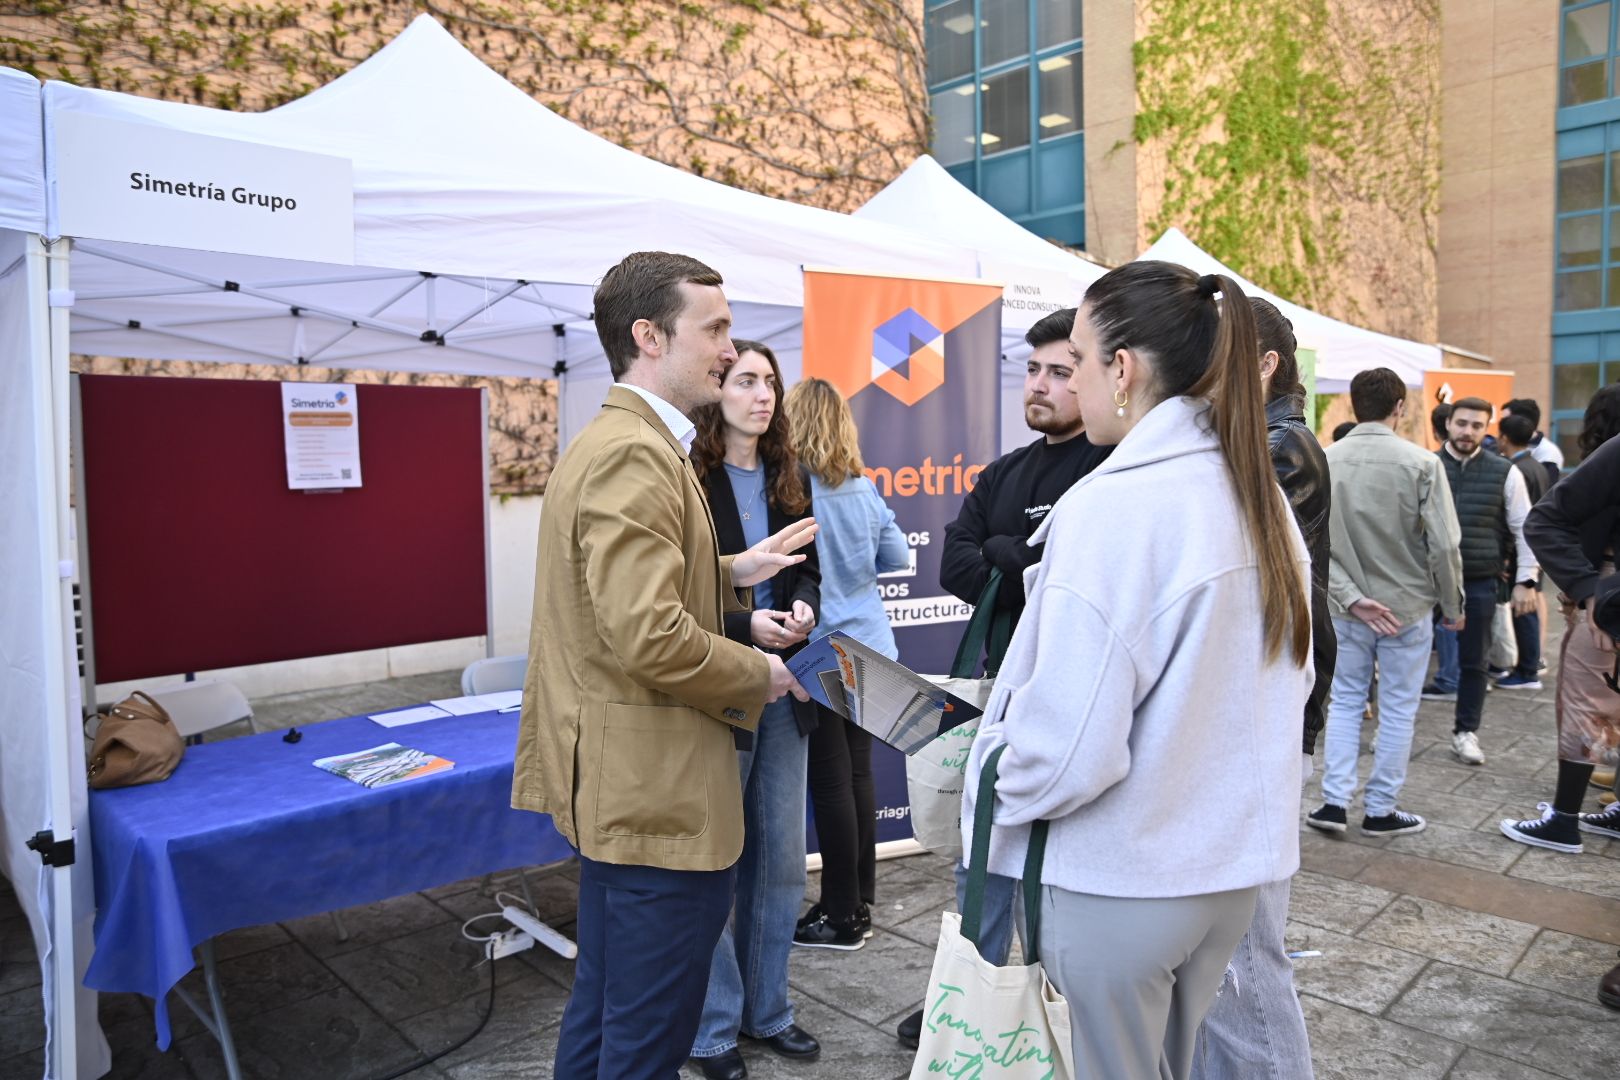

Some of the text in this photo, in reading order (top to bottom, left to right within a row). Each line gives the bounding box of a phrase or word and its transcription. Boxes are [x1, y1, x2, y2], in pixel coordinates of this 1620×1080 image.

[130, 172, 297, 212] Simetría Grupo
[1014, 285, 1042, 295] INNOVA
